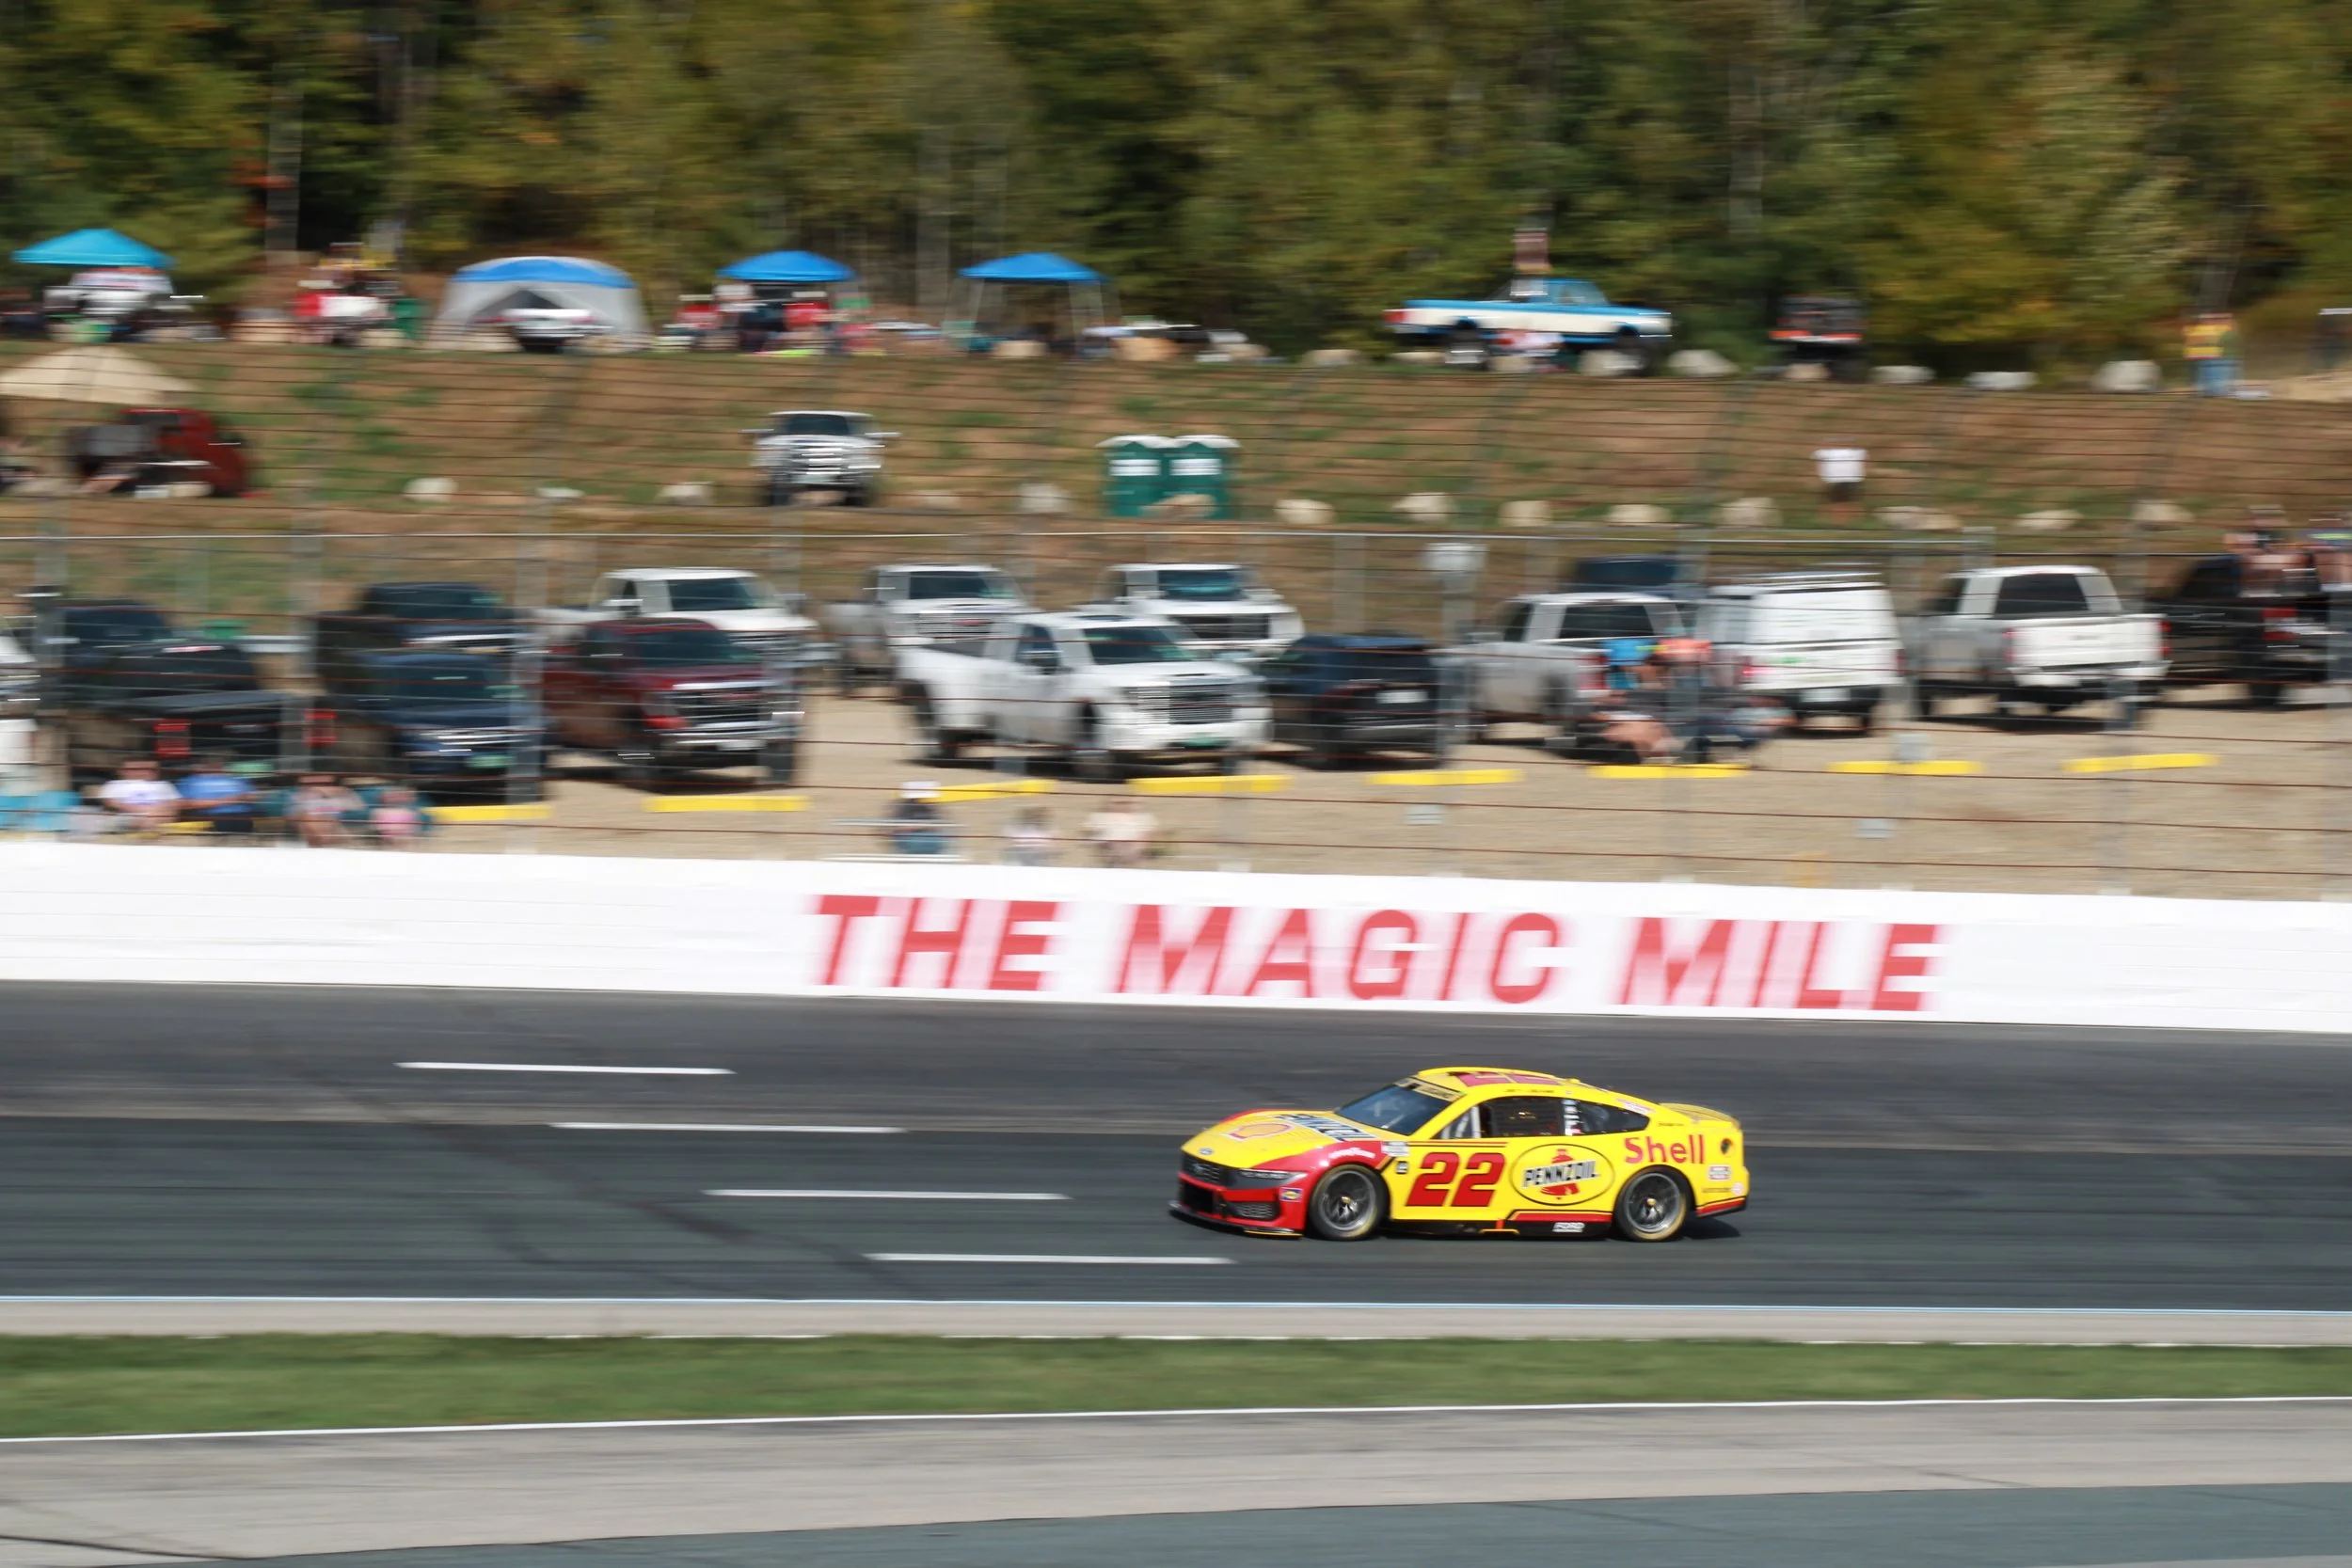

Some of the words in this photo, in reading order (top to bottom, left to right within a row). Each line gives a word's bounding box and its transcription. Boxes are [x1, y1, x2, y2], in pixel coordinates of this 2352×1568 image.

[813, 894, 1063, 991] THE
[1112, 903, 1564, 1005] MAGIC
[1613, 916, 1944, 1012] MILE
[1625, 1133, 1705, 1164] Shell
[1406, 1152, 1506, 1207] 22
[1522, 1160, 1599, 1188] PENNZOIL
